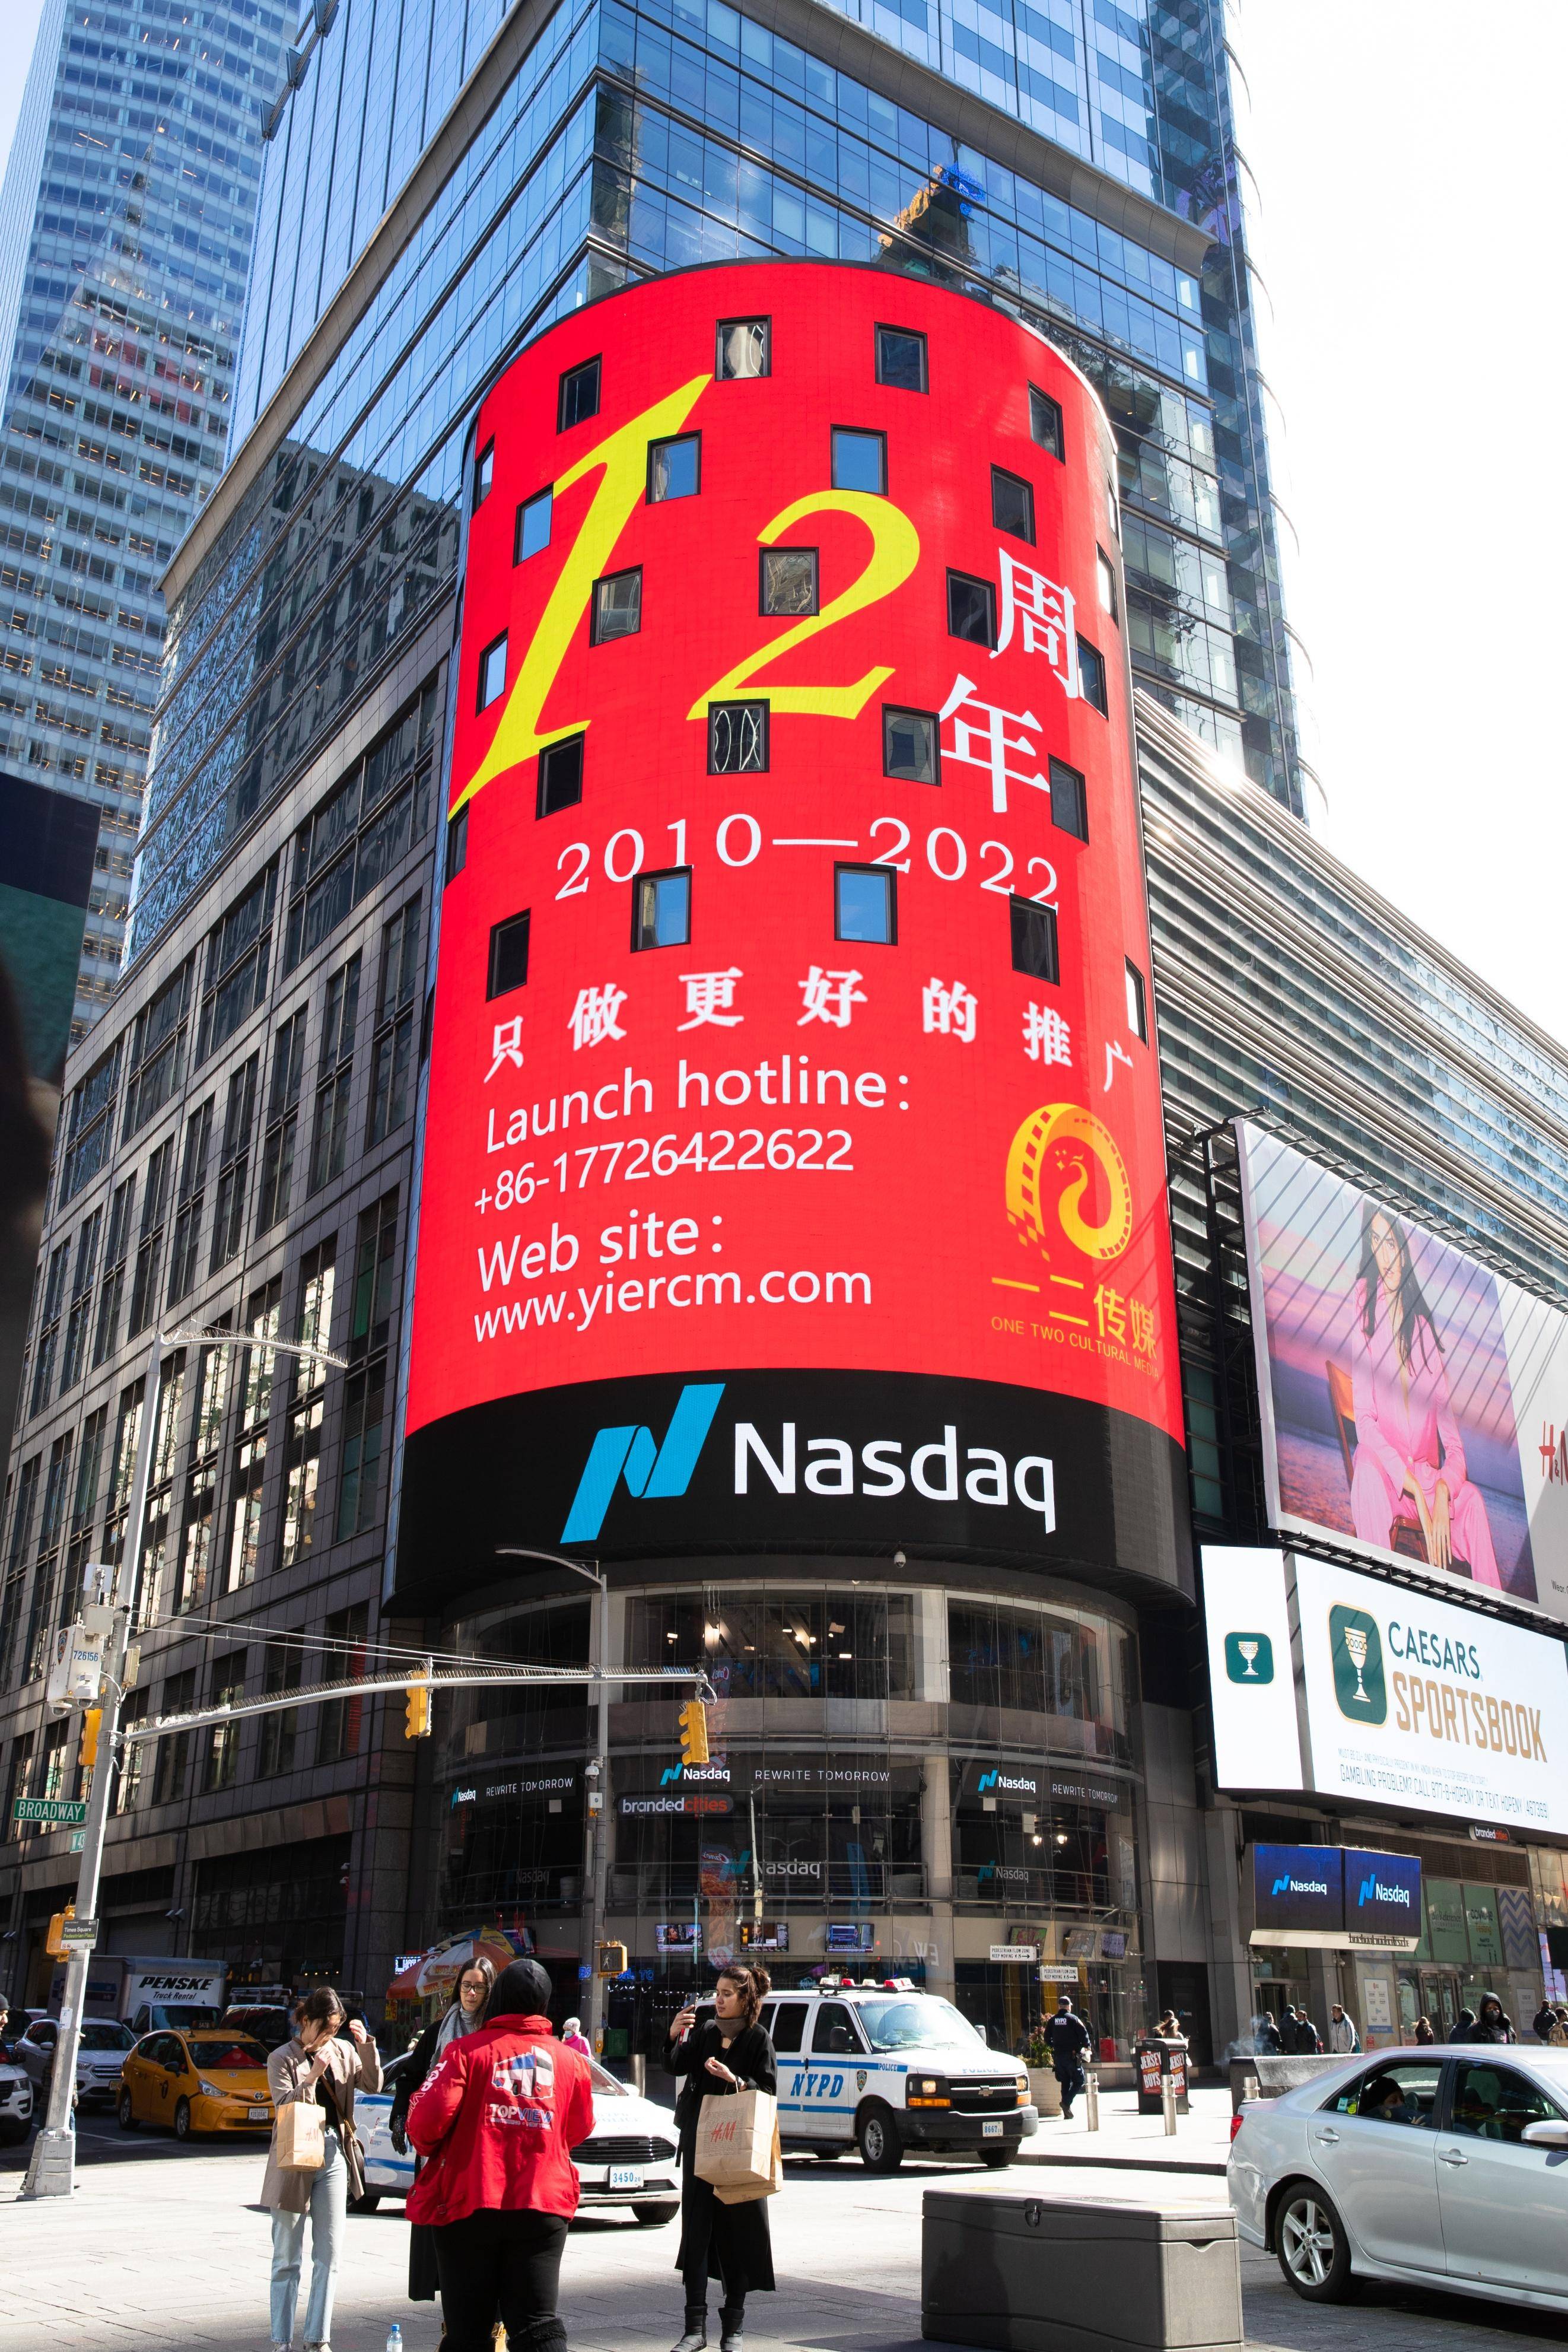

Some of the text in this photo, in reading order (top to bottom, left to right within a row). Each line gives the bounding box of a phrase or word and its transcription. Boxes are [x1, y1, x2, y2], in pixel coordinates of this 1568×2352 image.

[485, 1066, 653, 1154] Launch
[474, 1128, 855, 1215] +86-17726422622
[477, 1222, 579, 1292] Web
[473, 1269, 873, 1343] www.yiercm.com
[991, 1274, 1157, 1359] 一二传媒
[991, 1316, 1160, 1380] ONE TWO CULTURAL MEDIA
[734, 1422, 1056, 1534] Nasdaq
[1551, 1579, 1566, 1594] Wear.
[74, 1651, 98, 1662] 726156
[1388, 1621, 1480, 1679] CAESARS
[1392, 1671, 1547, 1763] SPORTSBOOK
[683, 1768, 730, 1782] Nasdaq
[755, 1770, 889, 1781] REWRITE TOMORROW
[486, 1778, 573, 1797] REWRITE TOMORROW
[998, 1776, 1036, 1793] Nasdaq
[1340, 1764, 1377, 1787] GAMBLING
[1378, 1771, 1413, 1794] PROBLEM?
[1414, 1778, 1430, 1797] CALL
[1475, 1790, 1484, 1807] OR
[1485, 1792, 1500, 1810] TEXT
[458, 1788, 476, 1802] Nasdaq
[1052, 1784, 1118, 1804] REWRITE TOMORROW
[18, 1801, 82, 1820] BROADWAY
[623, 1796, 727, 1813] brandedcities
[72, 1833, 85, 1850] W 43
[516, 1870, 549, 1885] Nasdaq
[753, 1858, 820, 1879] Nasdaq
[996, 1867, 1029, 1883] Nasdaq
[1290, 1880, 1327, 1895] Nasdaq
[1376, 1883, 1410, 1908] Nasdaq
[139, 1976, 214, 1991] PENSKE
[173, 1992, 198, 2000] Rental
[878, 2062, 898, 2072] POLICE
[1140, 2052, 1161, 2070] JERSEY
[1169, 2052, 1185, 2070] JERSEY
[790, 2073, 844, 2097] NYPD
[1143, 2071, 1161, 2089] BOYS
[489, 2103, 554, 2124] TOPVIEW
[613, 2172, 634, 2183] 3450
